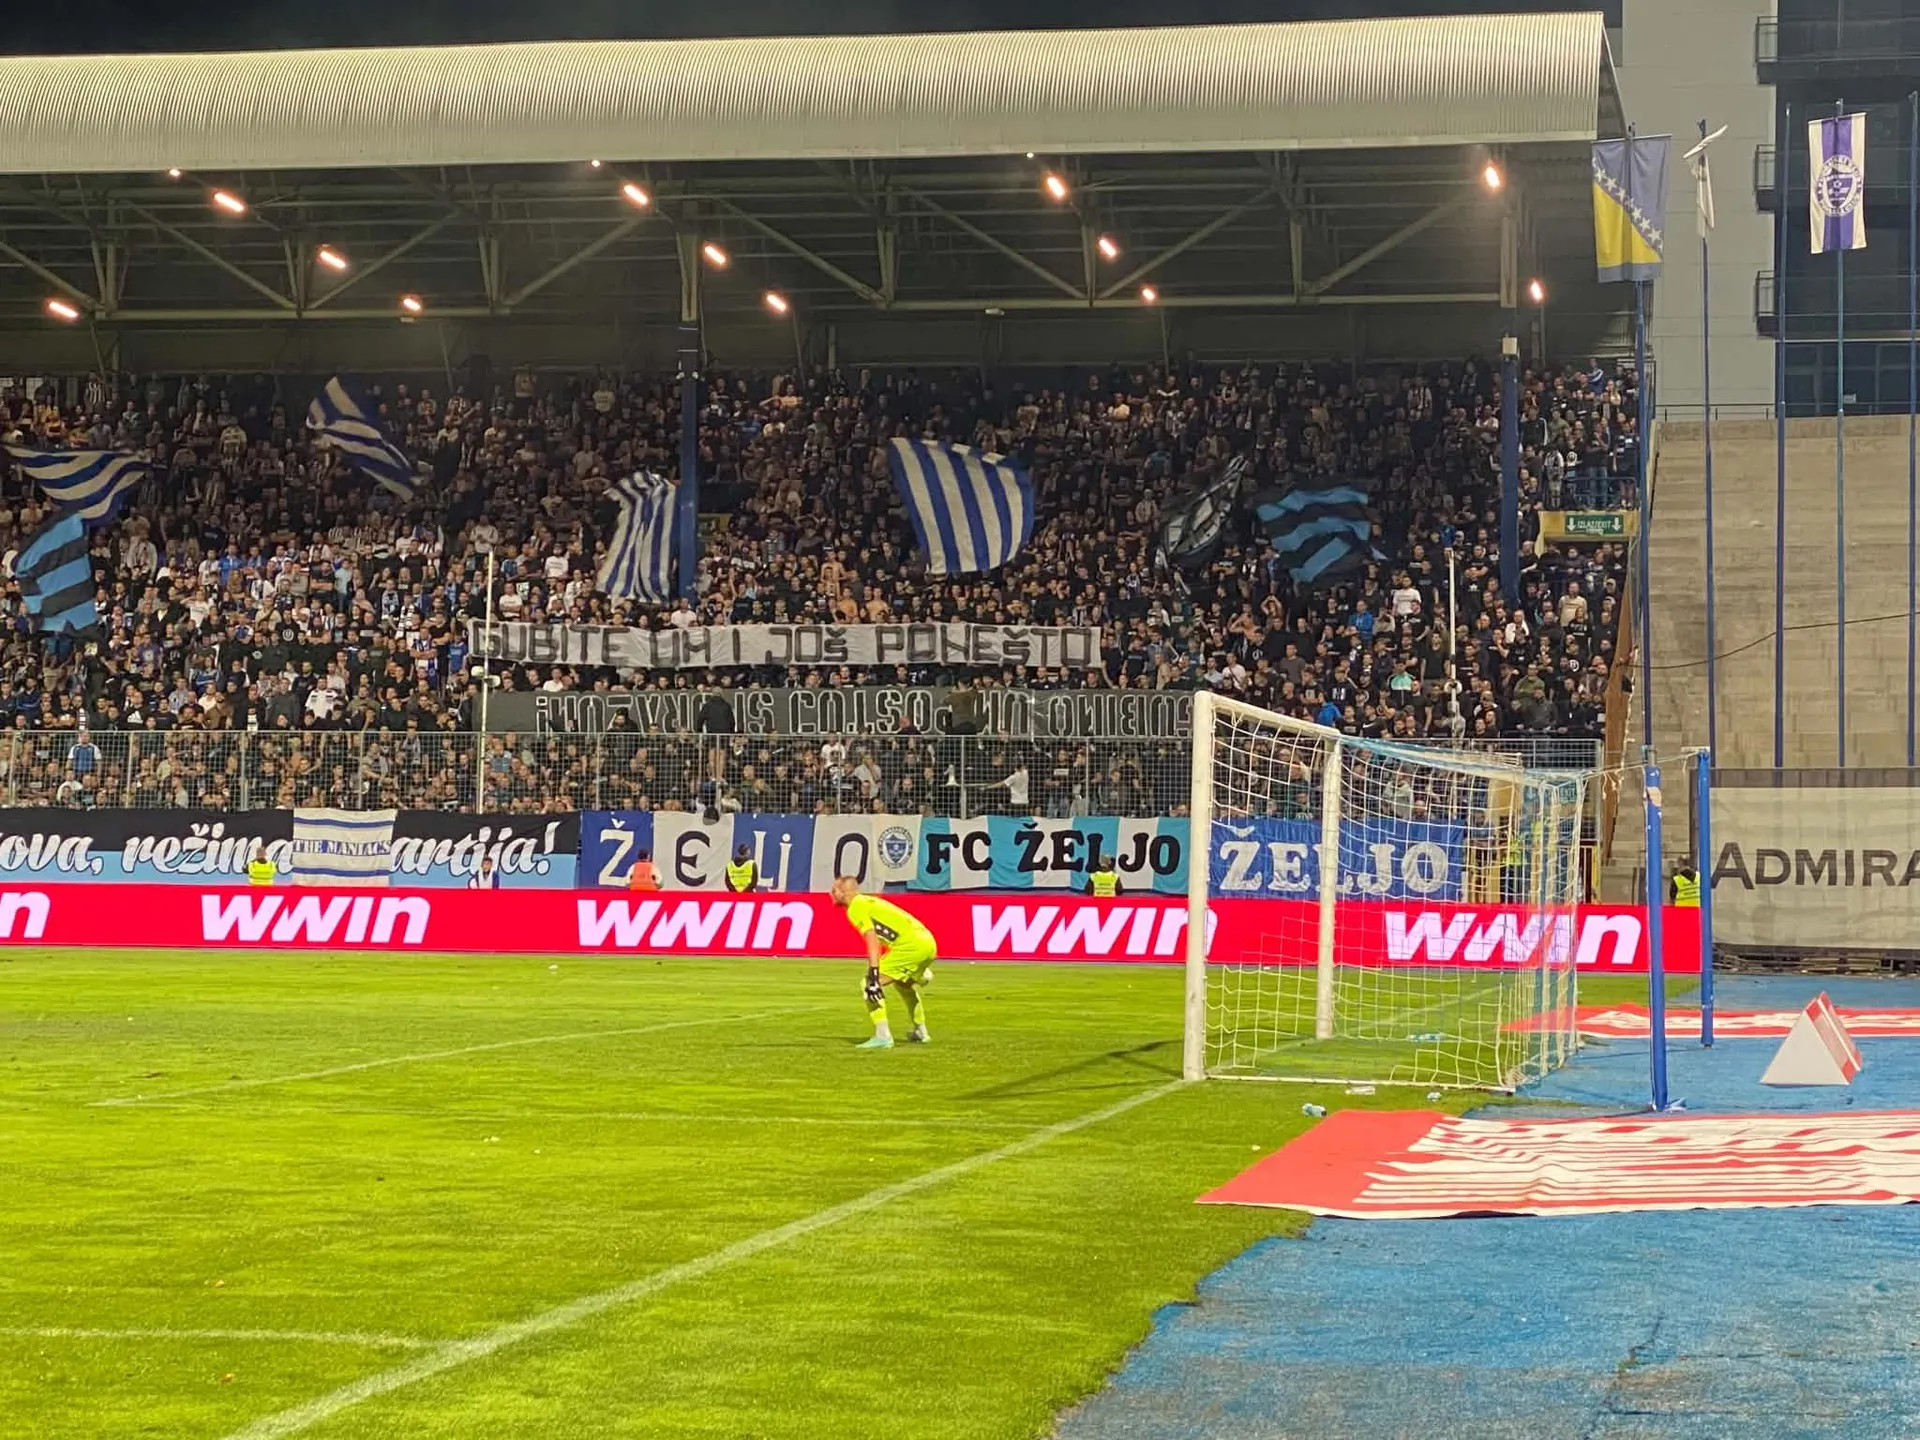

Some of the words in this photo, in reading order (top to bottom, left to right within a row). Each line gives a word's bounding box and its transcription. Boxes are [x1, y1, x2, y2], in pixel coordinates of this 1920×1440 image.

[473, 620, 631, 664] GUBITE
[731, 627, 741, 664] I
[764, 625, 848, 664] JOŠ
[875, 624, 1092, 666] PONEŠTO
[0, 832, 104, 876] ova,
[293, 839, 322, 854] THE
[327, 840, 391, 857] MANIACS
[925, 831, 992, 875] FC
[1014, 822, 1181, 876] ŽELJO
